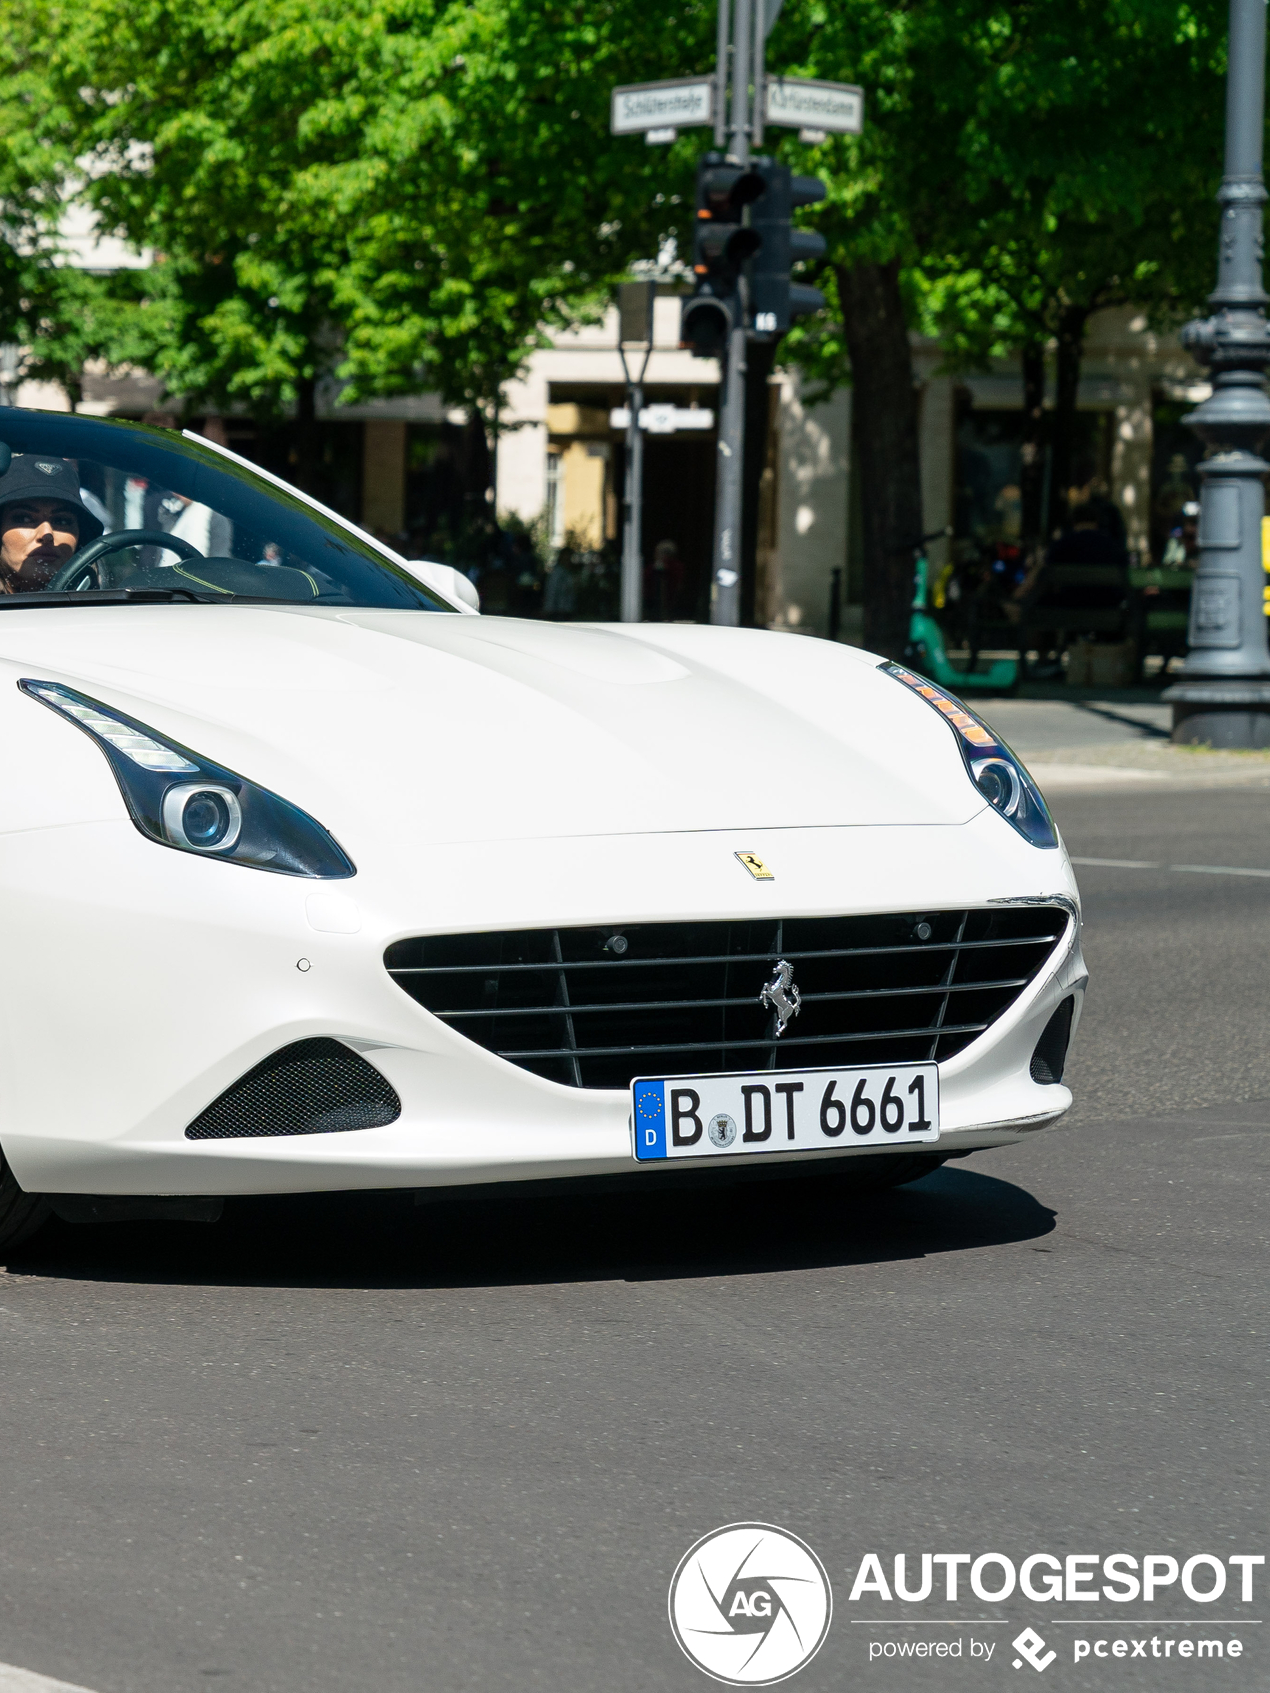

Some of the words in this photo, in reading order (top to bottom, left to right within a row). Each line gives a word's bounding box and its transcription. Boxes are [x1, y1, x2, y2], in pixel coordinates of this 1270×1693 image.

[670, 1088, 703, 1147] B
[740, 1082, 805, 1143] DT
[819, 1074, 932, 1137] 6661
[645, 1129, 657, 1146] D
